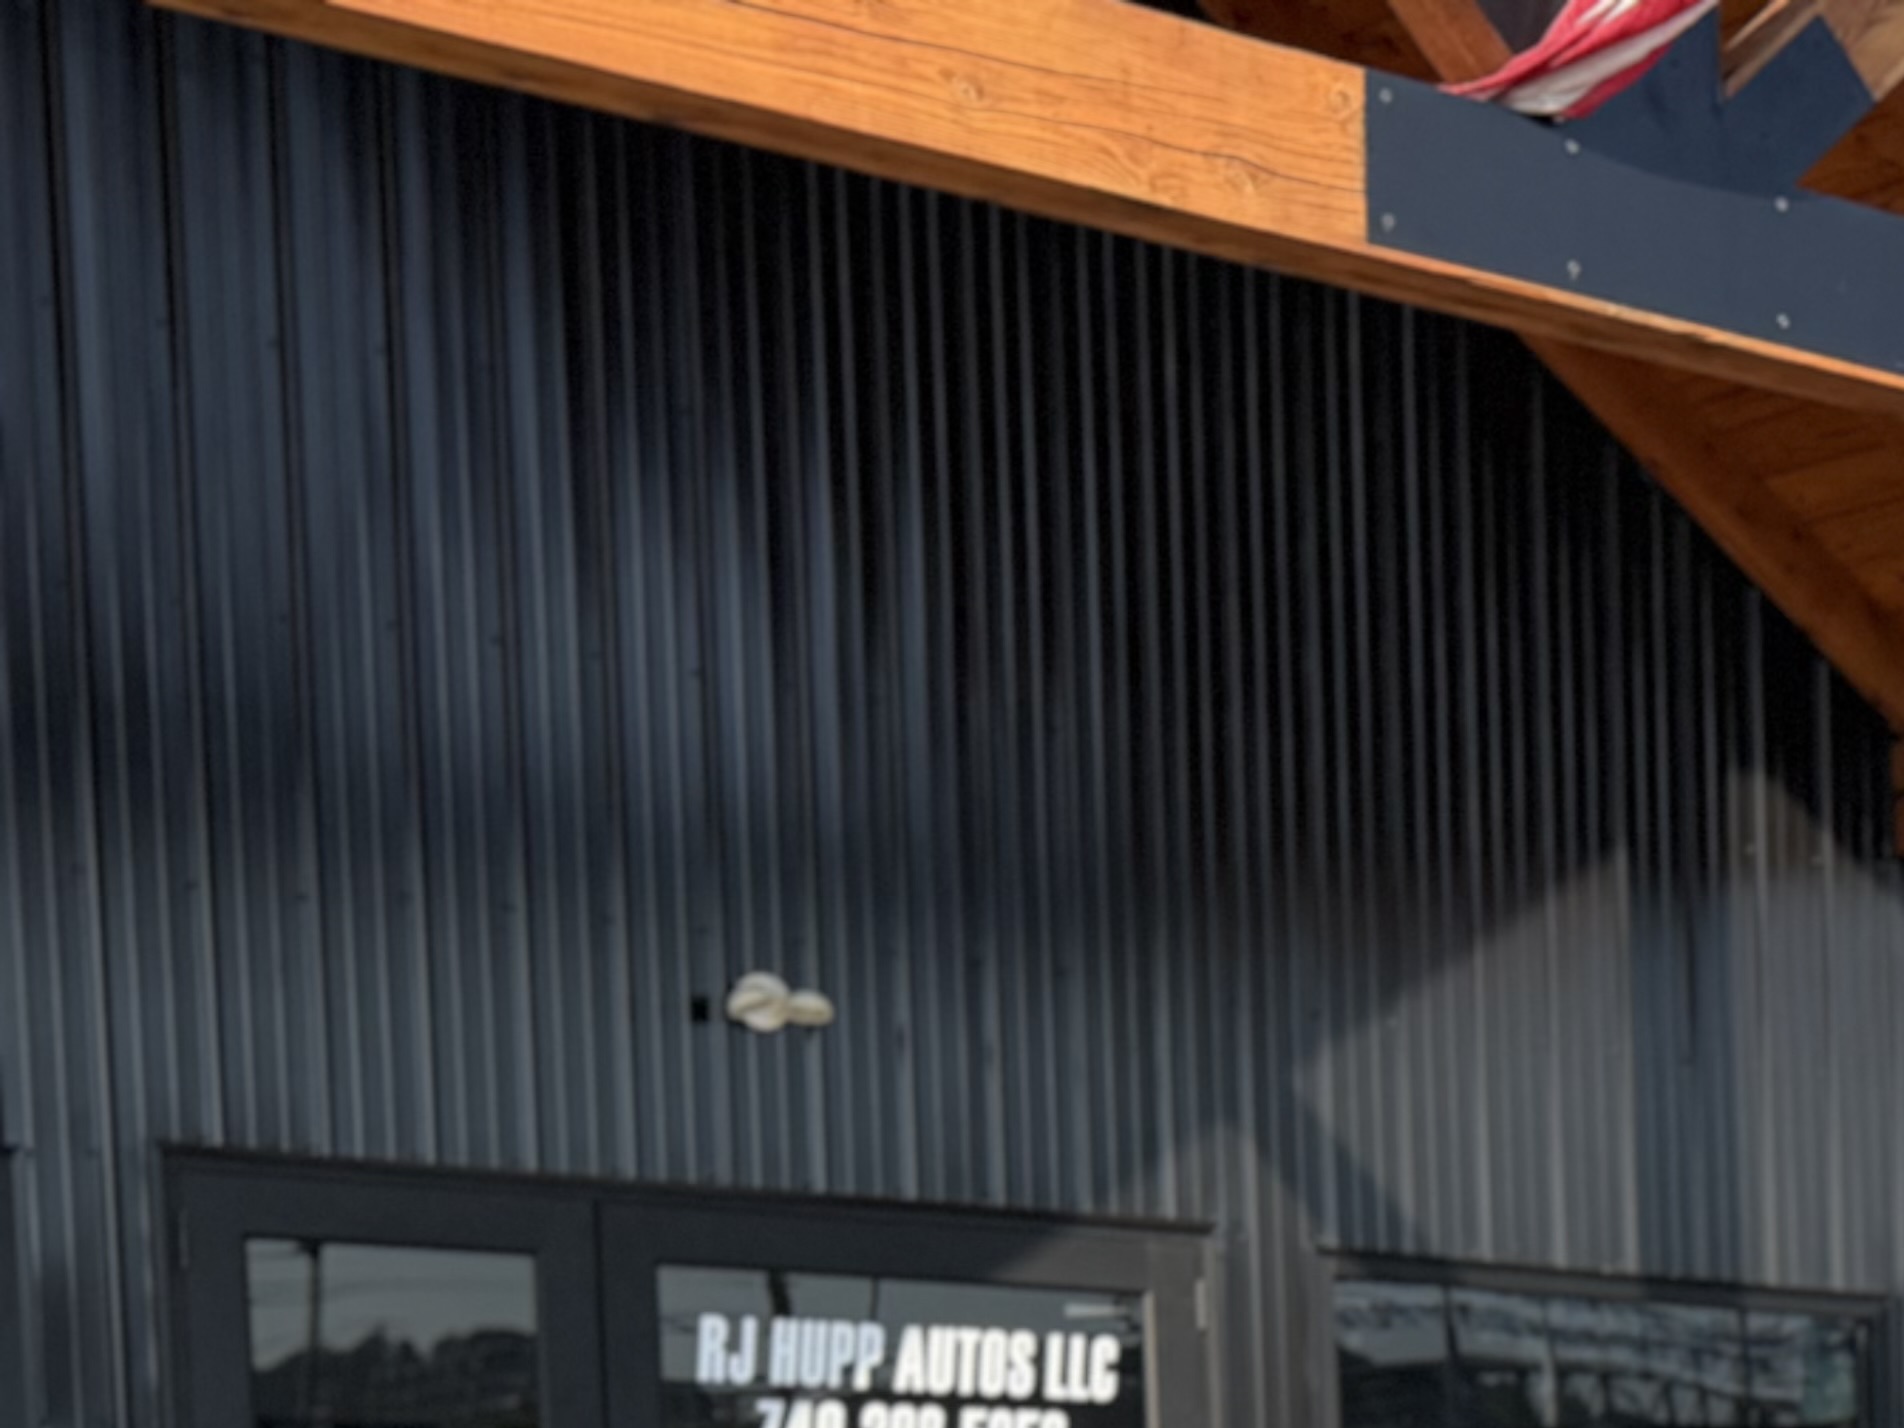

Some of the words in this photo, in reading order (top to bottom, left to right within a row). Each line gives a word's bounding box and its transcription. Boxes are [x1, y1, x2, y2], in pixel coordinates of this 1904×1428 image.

[696, 1313, 756, 1384] RJ
[769, 1317, 884, 1391] HUPP
[893, 1325, 1036, 1398] AUTOS
[1042, 1332, 1120, 1402] LLC
